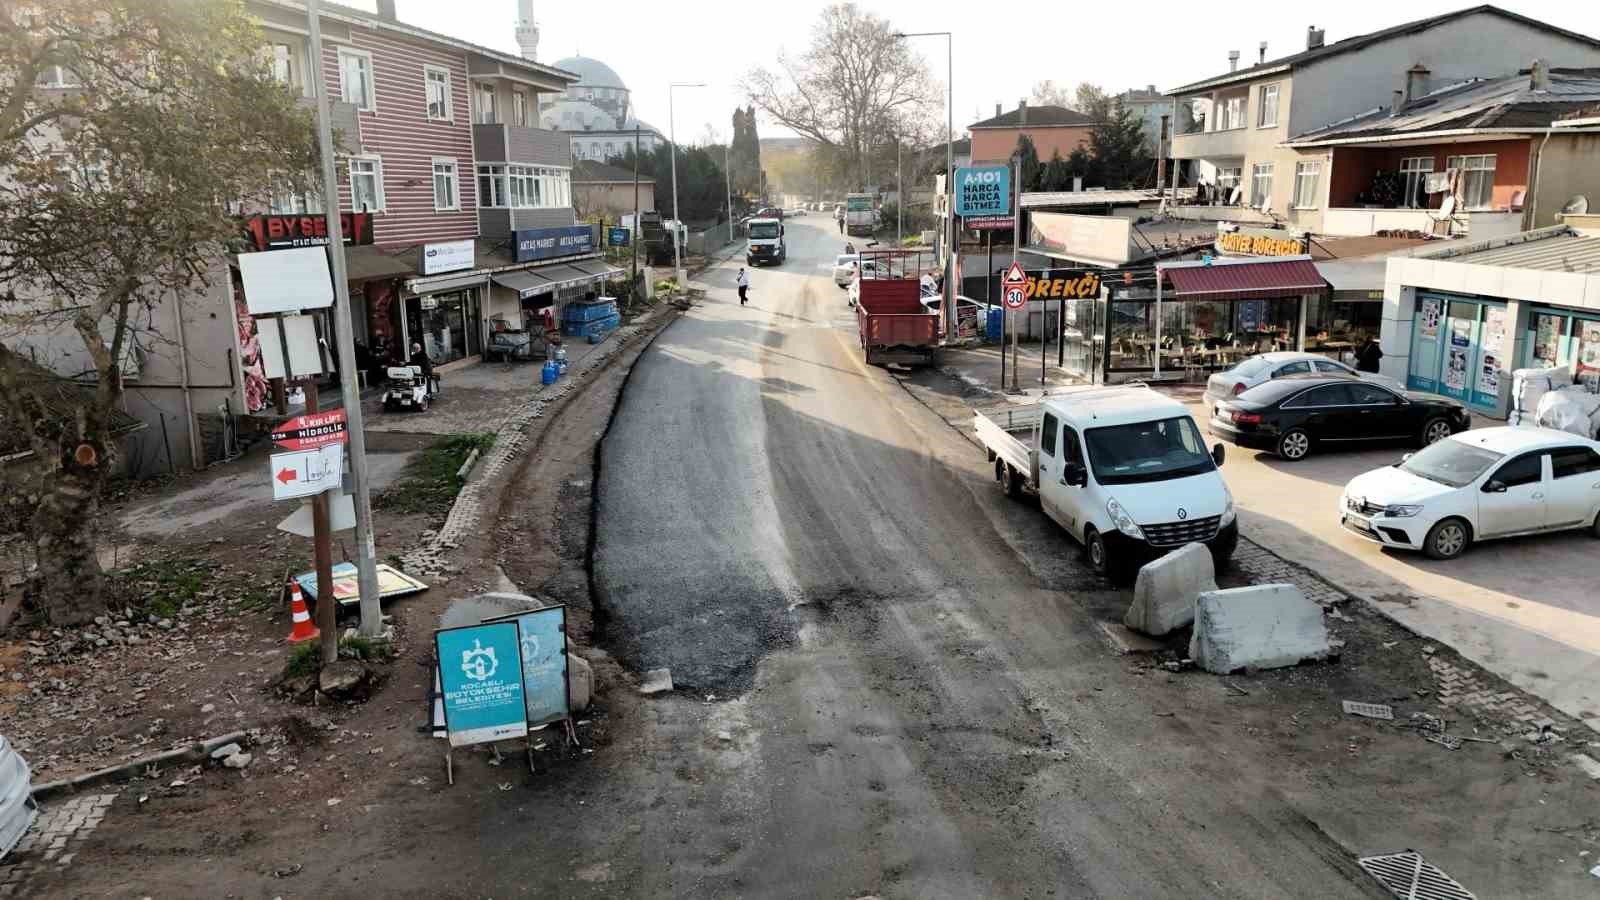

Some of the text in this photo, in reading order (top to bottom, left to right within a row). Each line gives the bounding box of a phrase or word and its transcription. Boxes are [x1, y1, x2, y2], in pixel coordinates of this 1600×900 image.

[963, 184, 1000, 192] HARCA
[963, 193, 1000, 201] HARCA
[267, 217, 296, 238] BY
[536, 237, 555, 248] MARKET
[1024, 274, 1099, 298] ÖREKÇİ
[1009, 291, 1022, 303] 30
[299, 424, 343, 437] HİDROLİK
